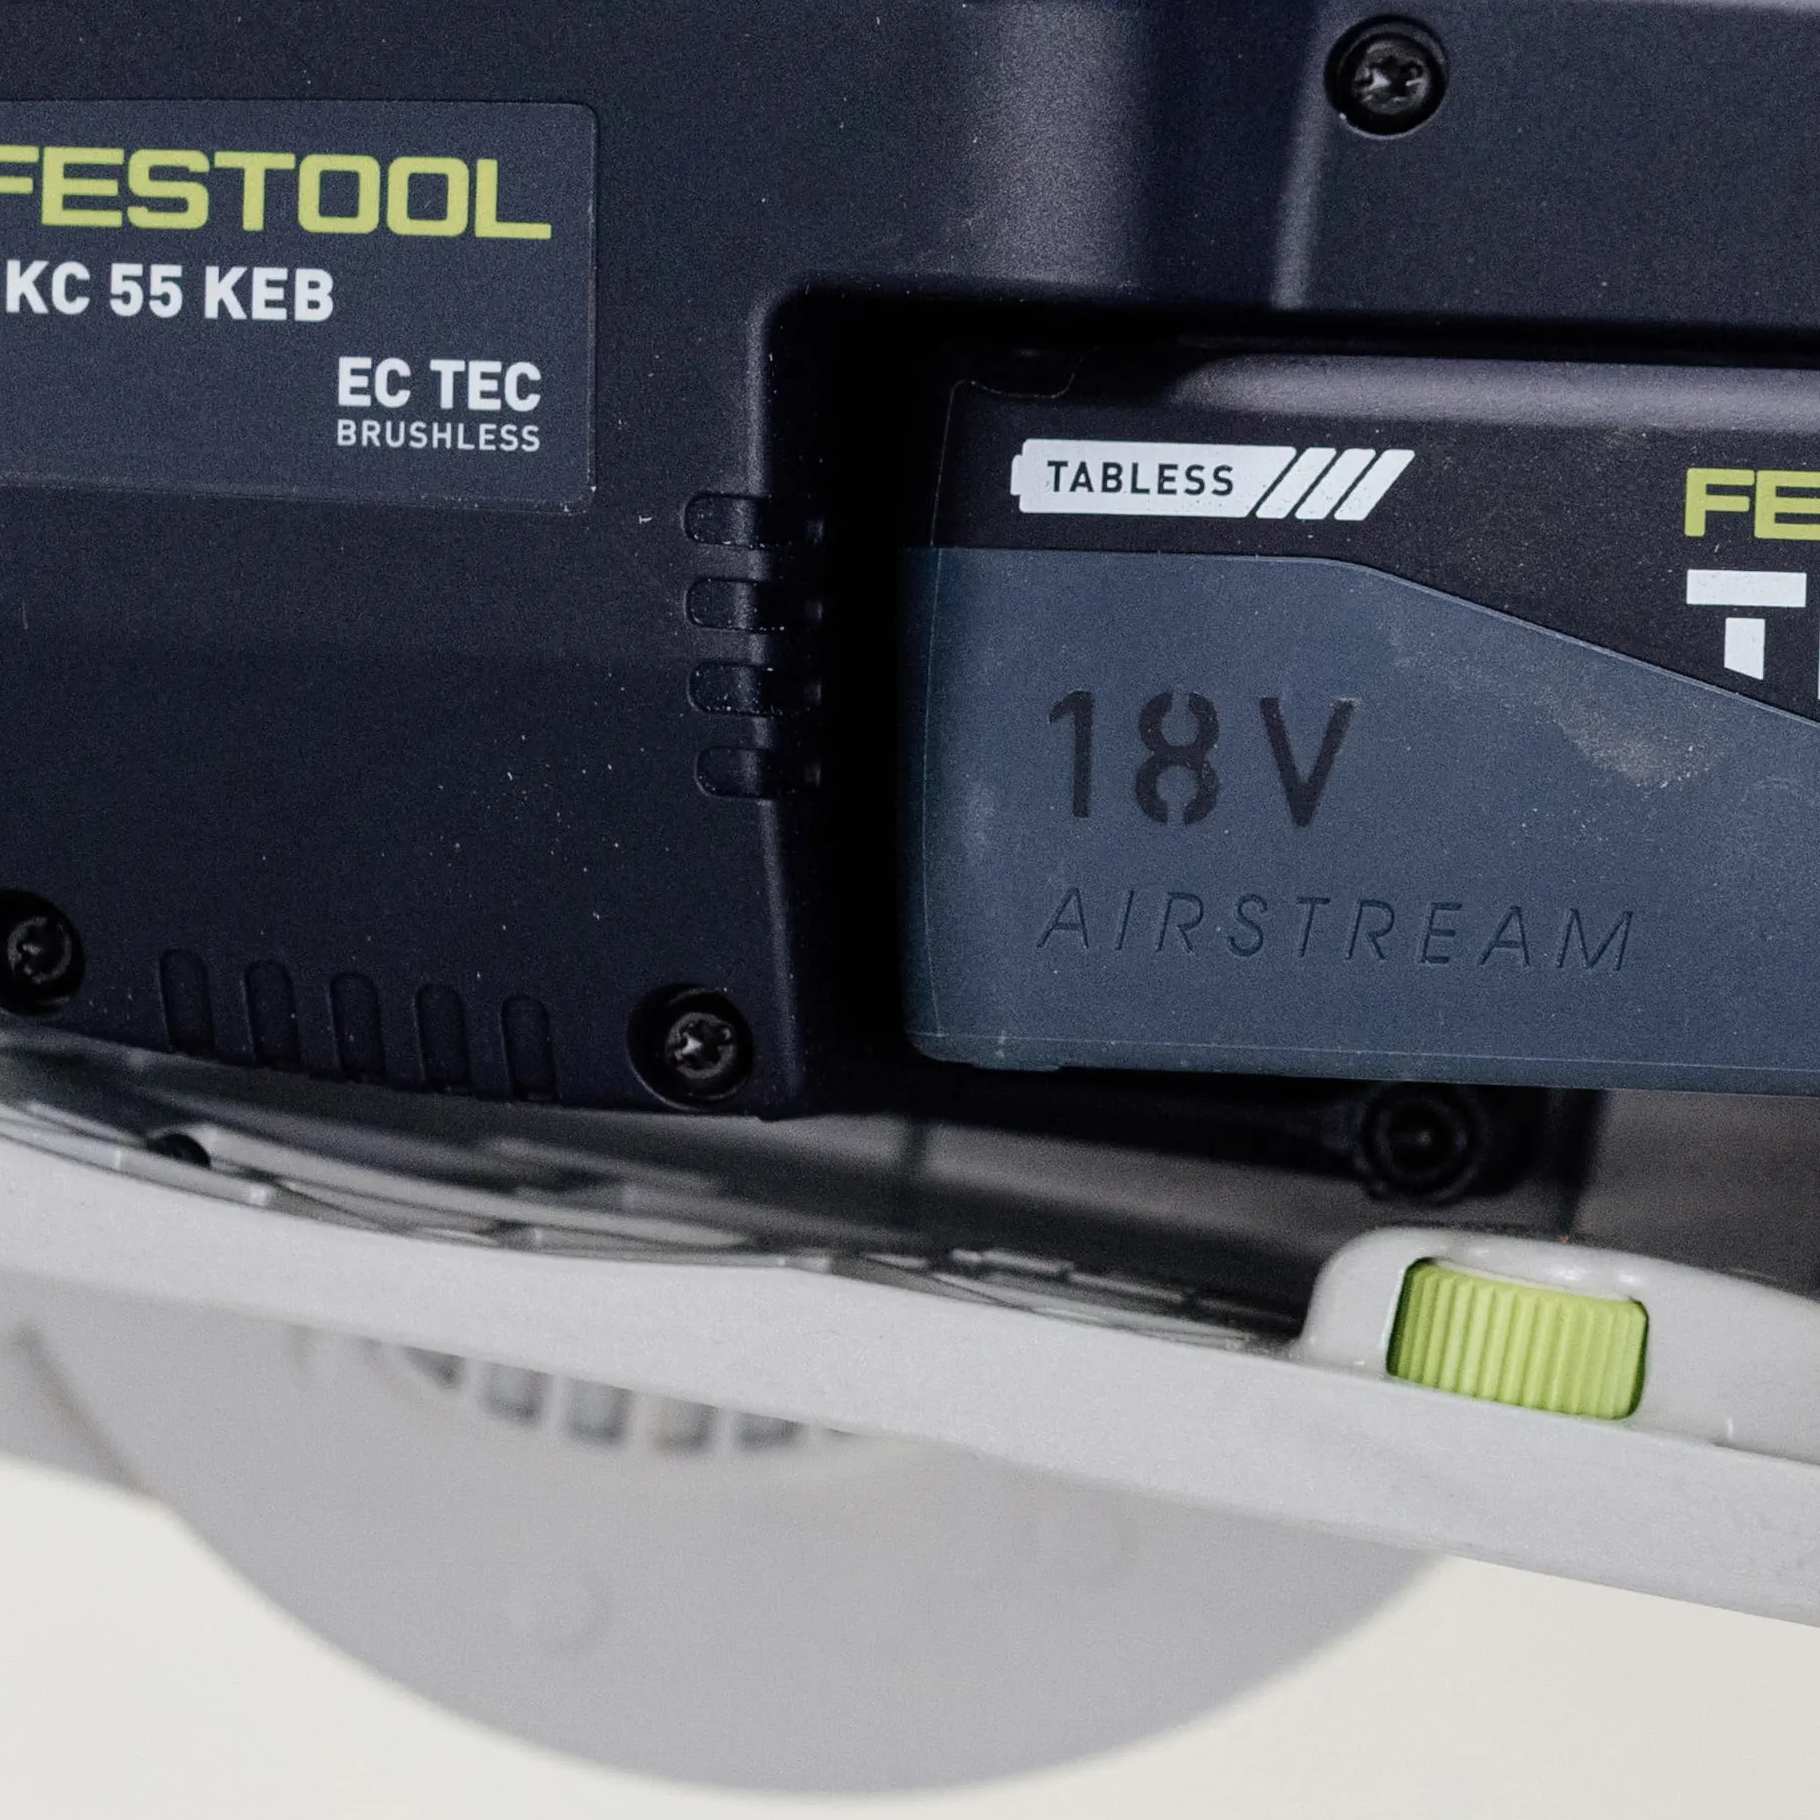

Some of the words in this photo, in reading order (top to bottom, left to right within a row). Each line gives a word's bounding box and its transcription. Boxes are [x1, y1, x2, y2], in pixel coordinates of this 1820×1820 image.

[108, 263, 183, 319] 55
[204, 265, 335, 322] KEB
[337, 355, 412, 409] EC
[430, 359, 542, 413] TEC
[337, 419, 541, 453] BRUSHLESS
[1047, 459, 1235, 497] TABLESS
[1047, 689, 1221, 827] 18
[1259, 696, 1356, 828] V
[1037, 886, 1635, 972] AIRSTREAM
